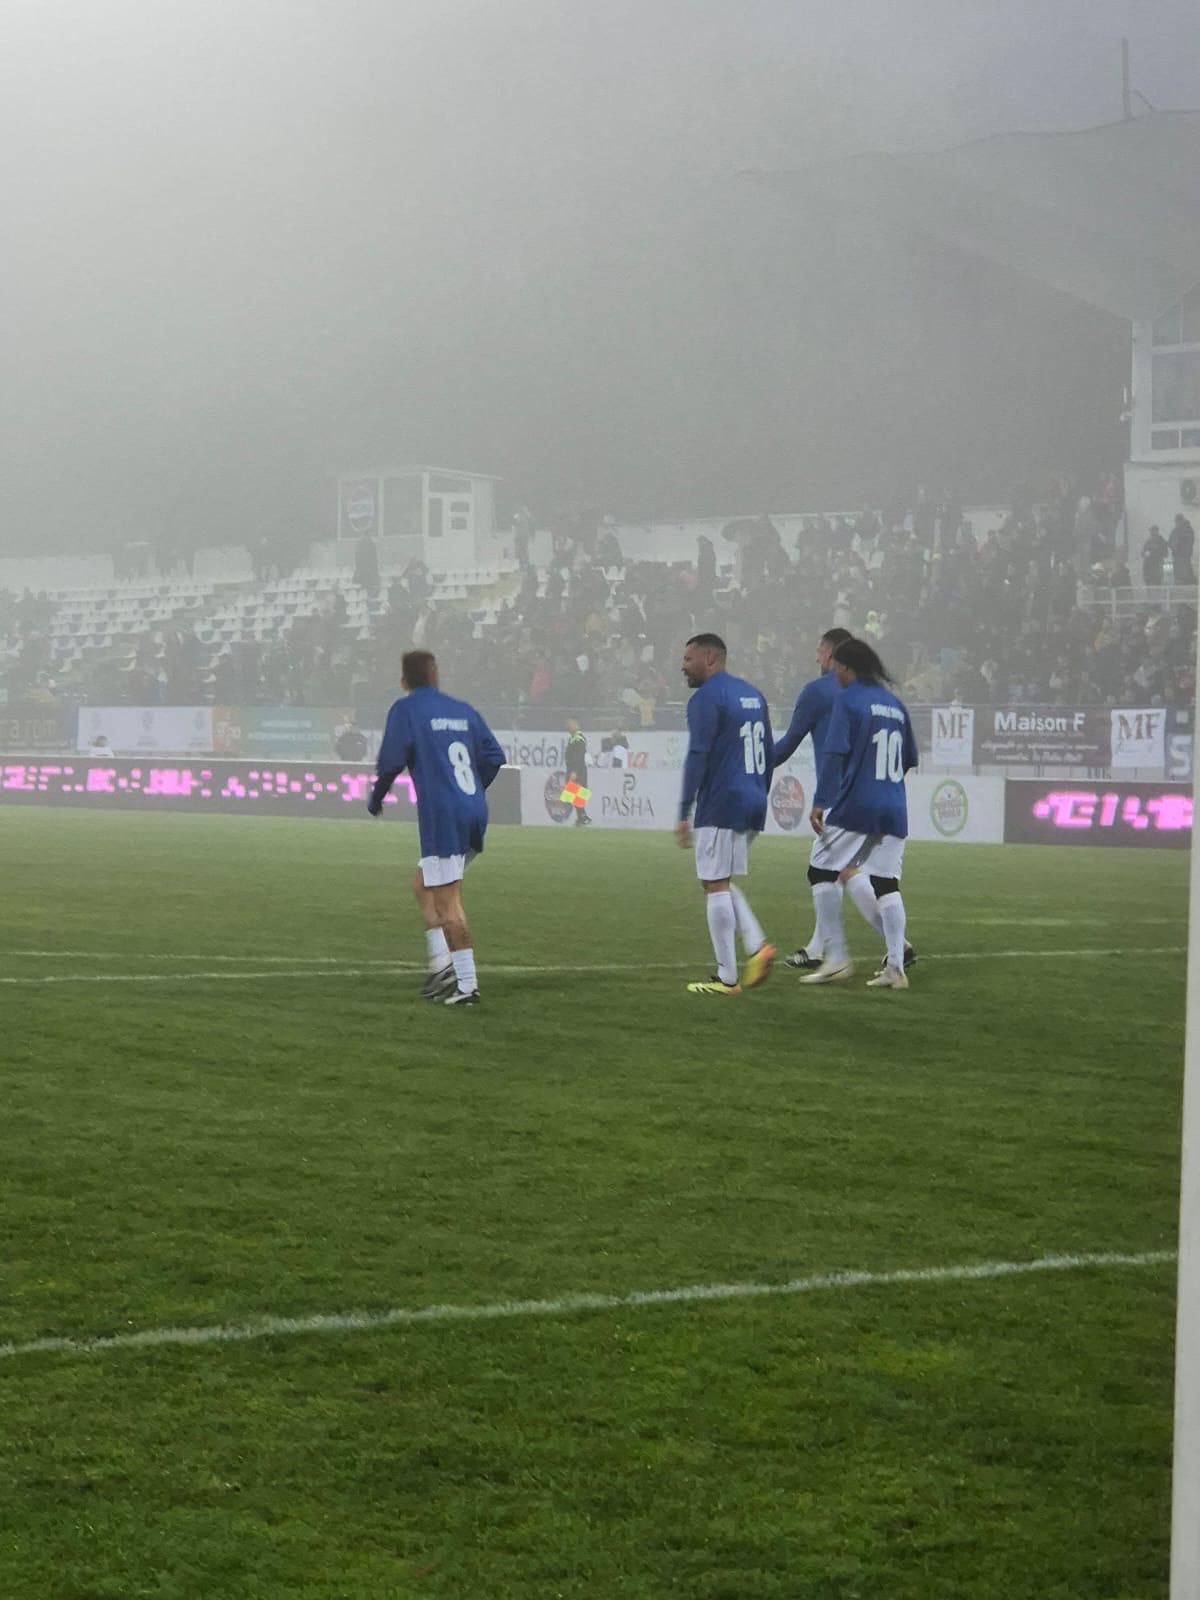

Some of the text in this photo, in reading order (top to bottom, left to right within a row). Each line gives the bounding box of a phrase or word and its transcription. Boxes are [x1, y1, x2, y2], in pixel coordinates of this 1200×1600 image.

[937, 711, 969, 739] MF
[994, 711, 1086, 732] Maison F
[1118, 712, 1160, 740] MF
[740, 720, 766, 776] 16
[872, 728, 904, 783] 10
[448, 741, 477, 796] 8
[601, 796, 655, 817] PASHA
